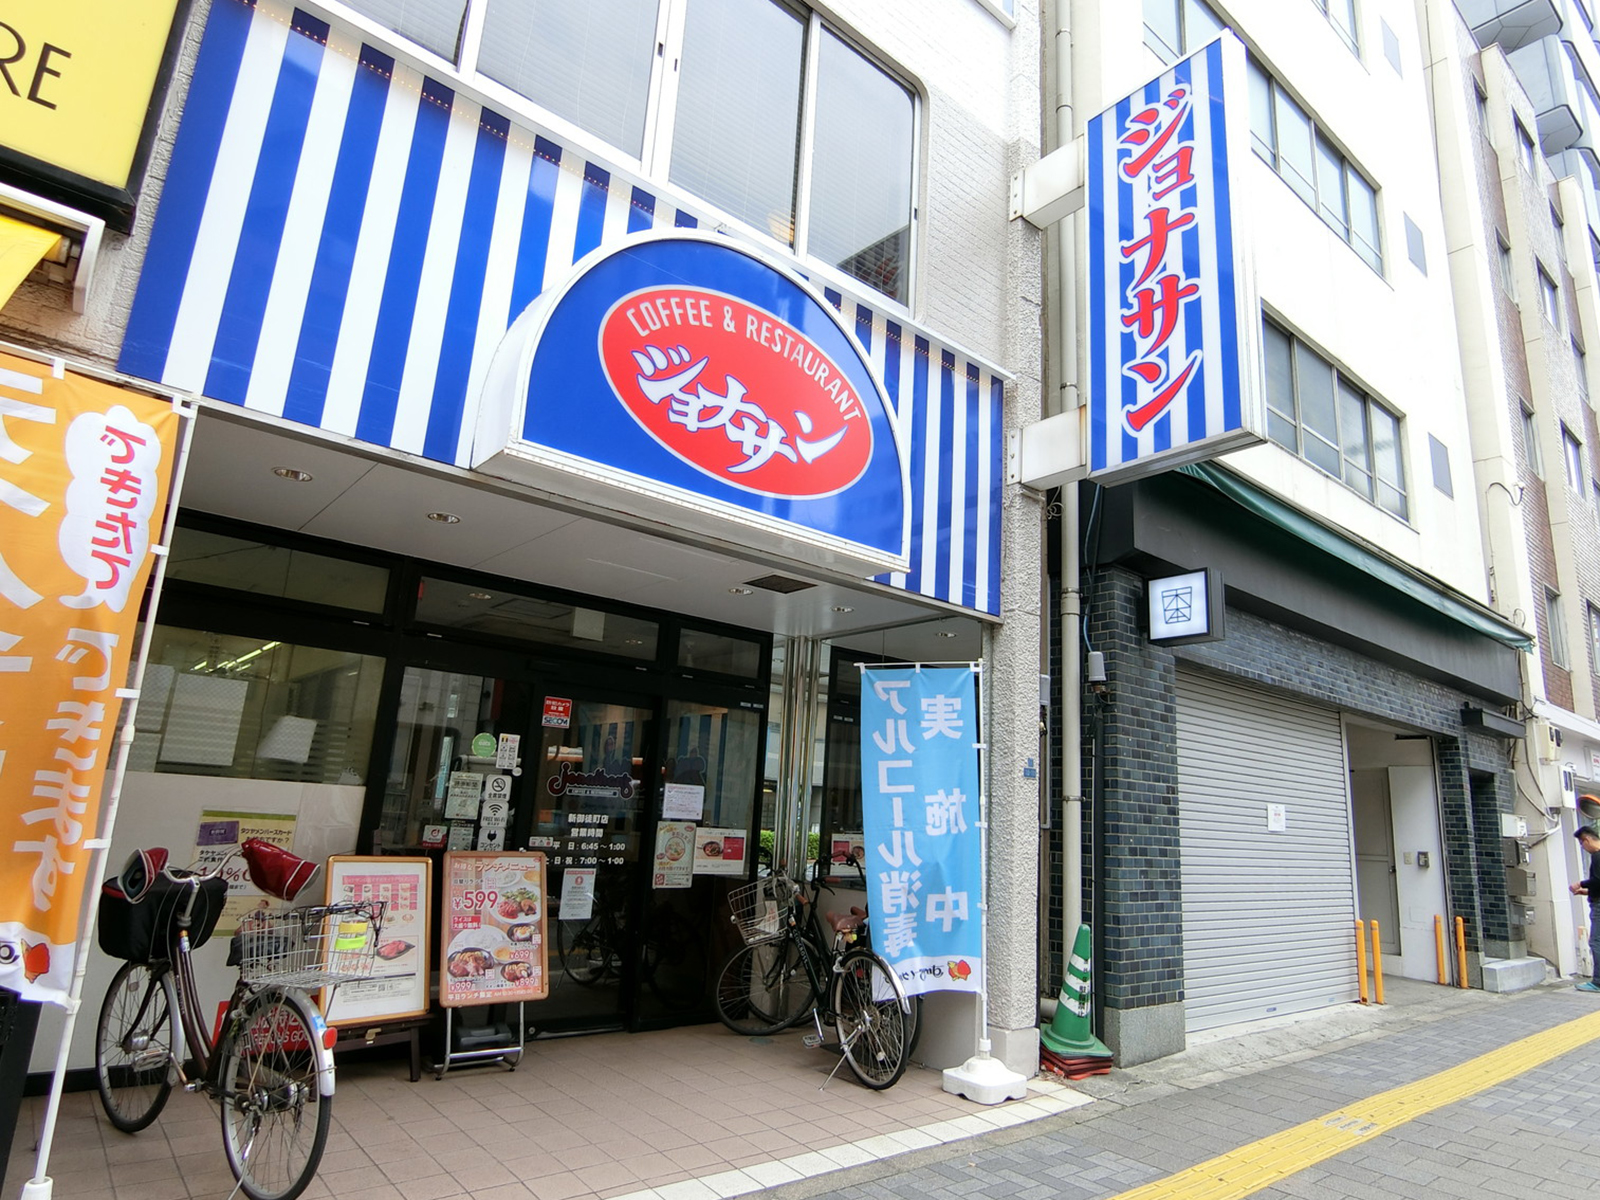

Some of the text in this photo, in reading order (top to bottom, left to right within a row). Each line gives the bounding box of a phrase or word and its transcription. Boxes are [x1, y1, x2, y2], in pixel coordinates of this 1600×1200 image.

[1118, 86, 1202, 434] ジョナサン
[626, 297, 862, 421] COFFEE & RESTAURANT
[631, 344, 849, 473] ジョナサン
[544, 716, 568, 726] SECOM
[571, 828, 604, 838] 営業時間
[475, 861, 536, 872] ランチメニュー
[454, 890, 498, 910] ¥599
